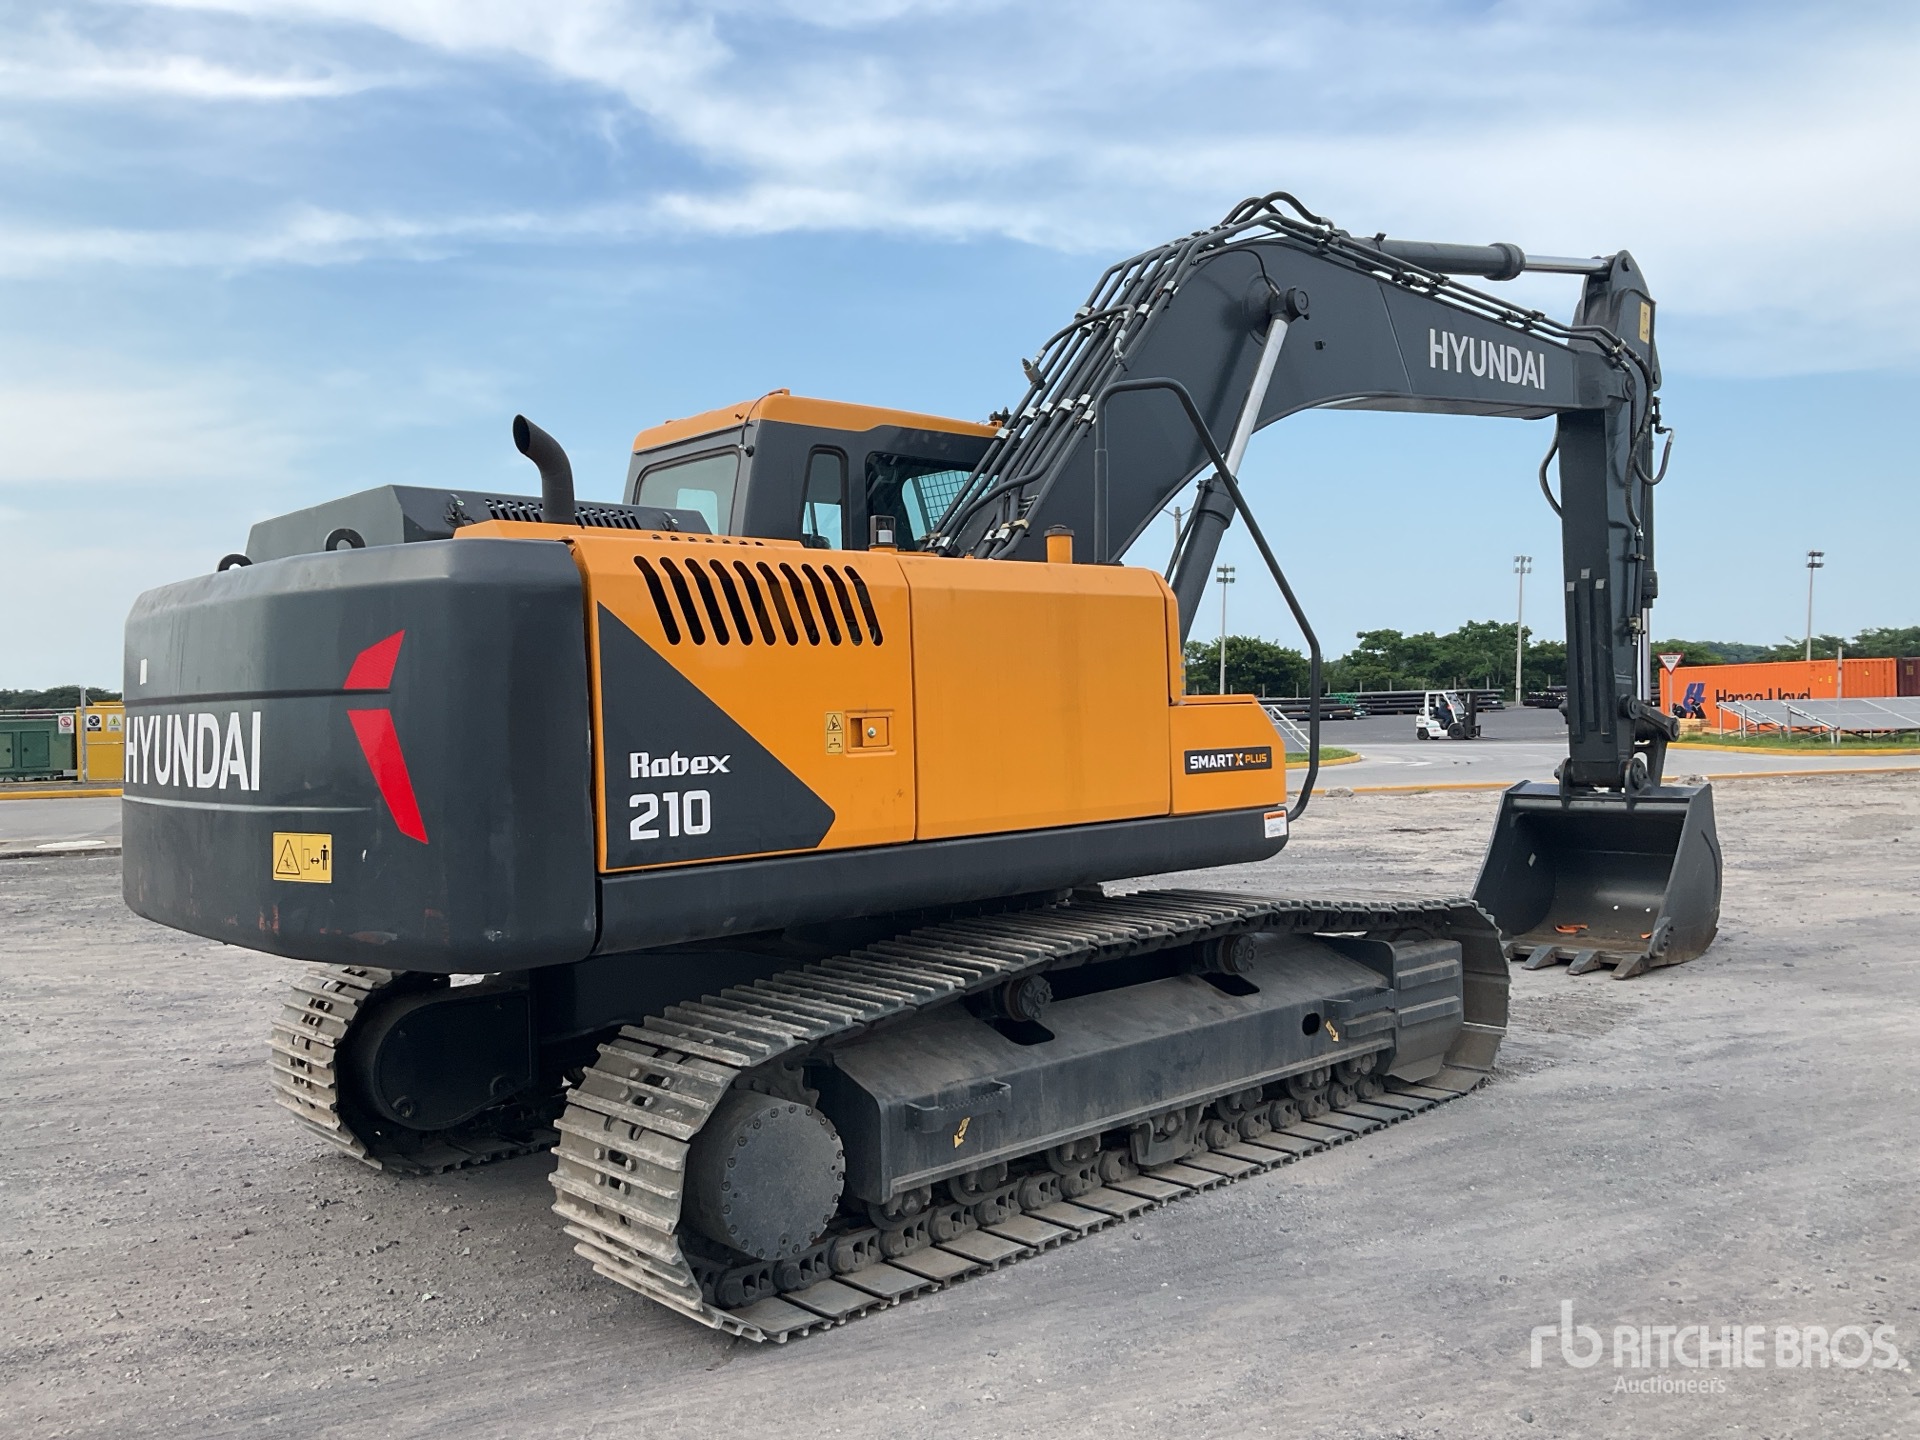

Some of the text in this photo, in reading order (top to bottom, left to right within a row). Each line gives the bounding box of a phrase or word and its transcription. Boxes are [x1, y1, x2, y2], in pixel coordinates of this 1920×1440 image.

[1429, 328, 1545, 390] HYUNDAI
[125, 711, 261, 791] HYUNDAI
[629, 750, 731, 778] Robex
[1190, 754, 1233, 769] SMART
[1245, 753, 1267, 763] PLUS
[629, 789, 711, 841] 210
